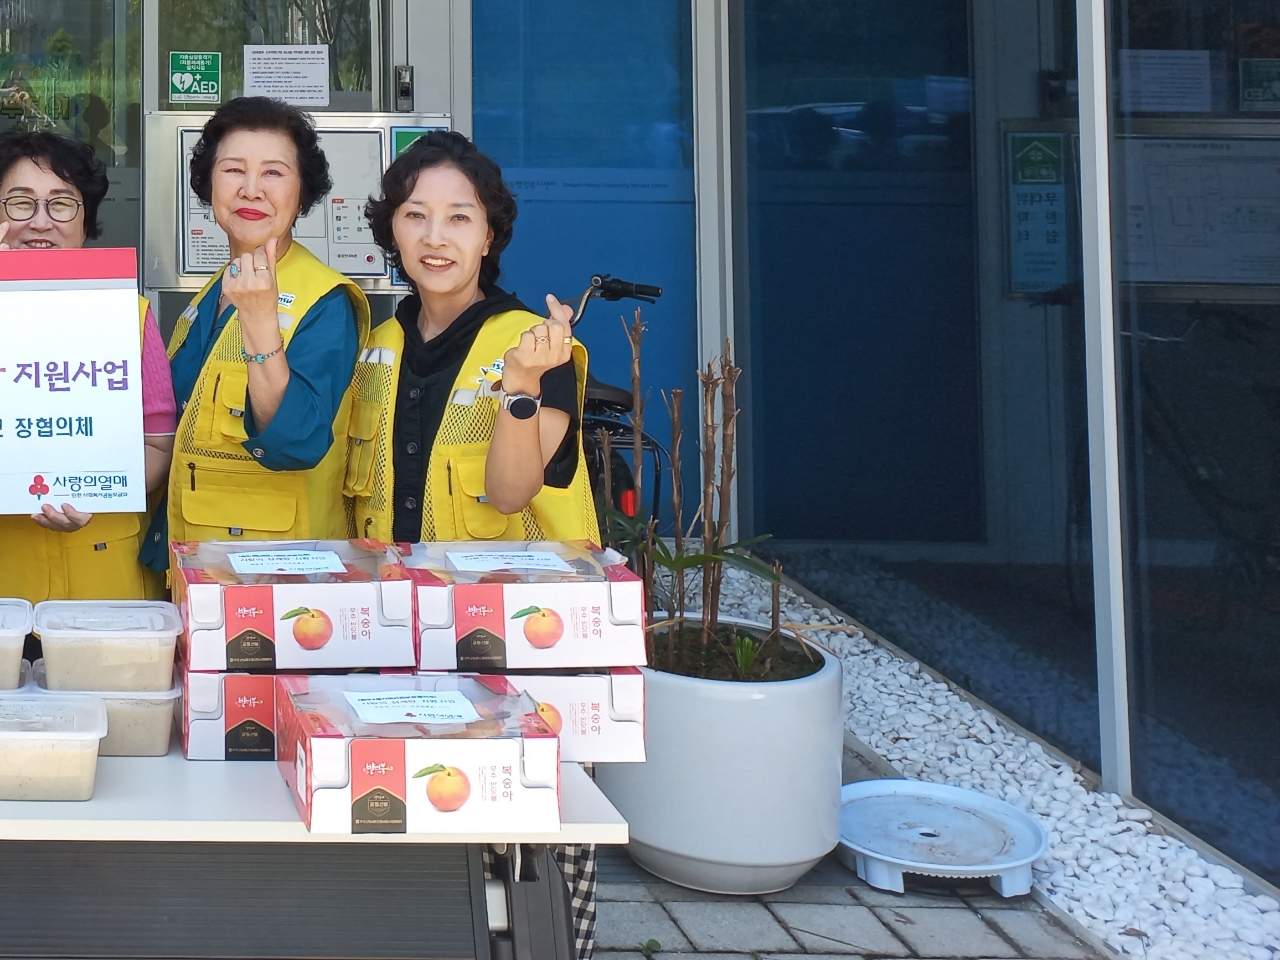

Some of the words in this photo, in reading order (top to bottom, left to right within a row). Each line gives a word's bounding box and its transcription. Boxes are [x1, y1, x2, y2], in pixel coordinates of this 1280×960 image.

[191, 81, 218, 93] AED
[13, 359, 130, 392] 지원사업
[14, 416, 95, 440] 장협의체
[52, 475, 128, 492] 사랑의열매
[360, 607, 371, 640] 복숭아
[591, 605, 602, 638] 복숭아
[590, 702, 601, 735] 복숭아
[501, 765, 513, 802] 복숭아
